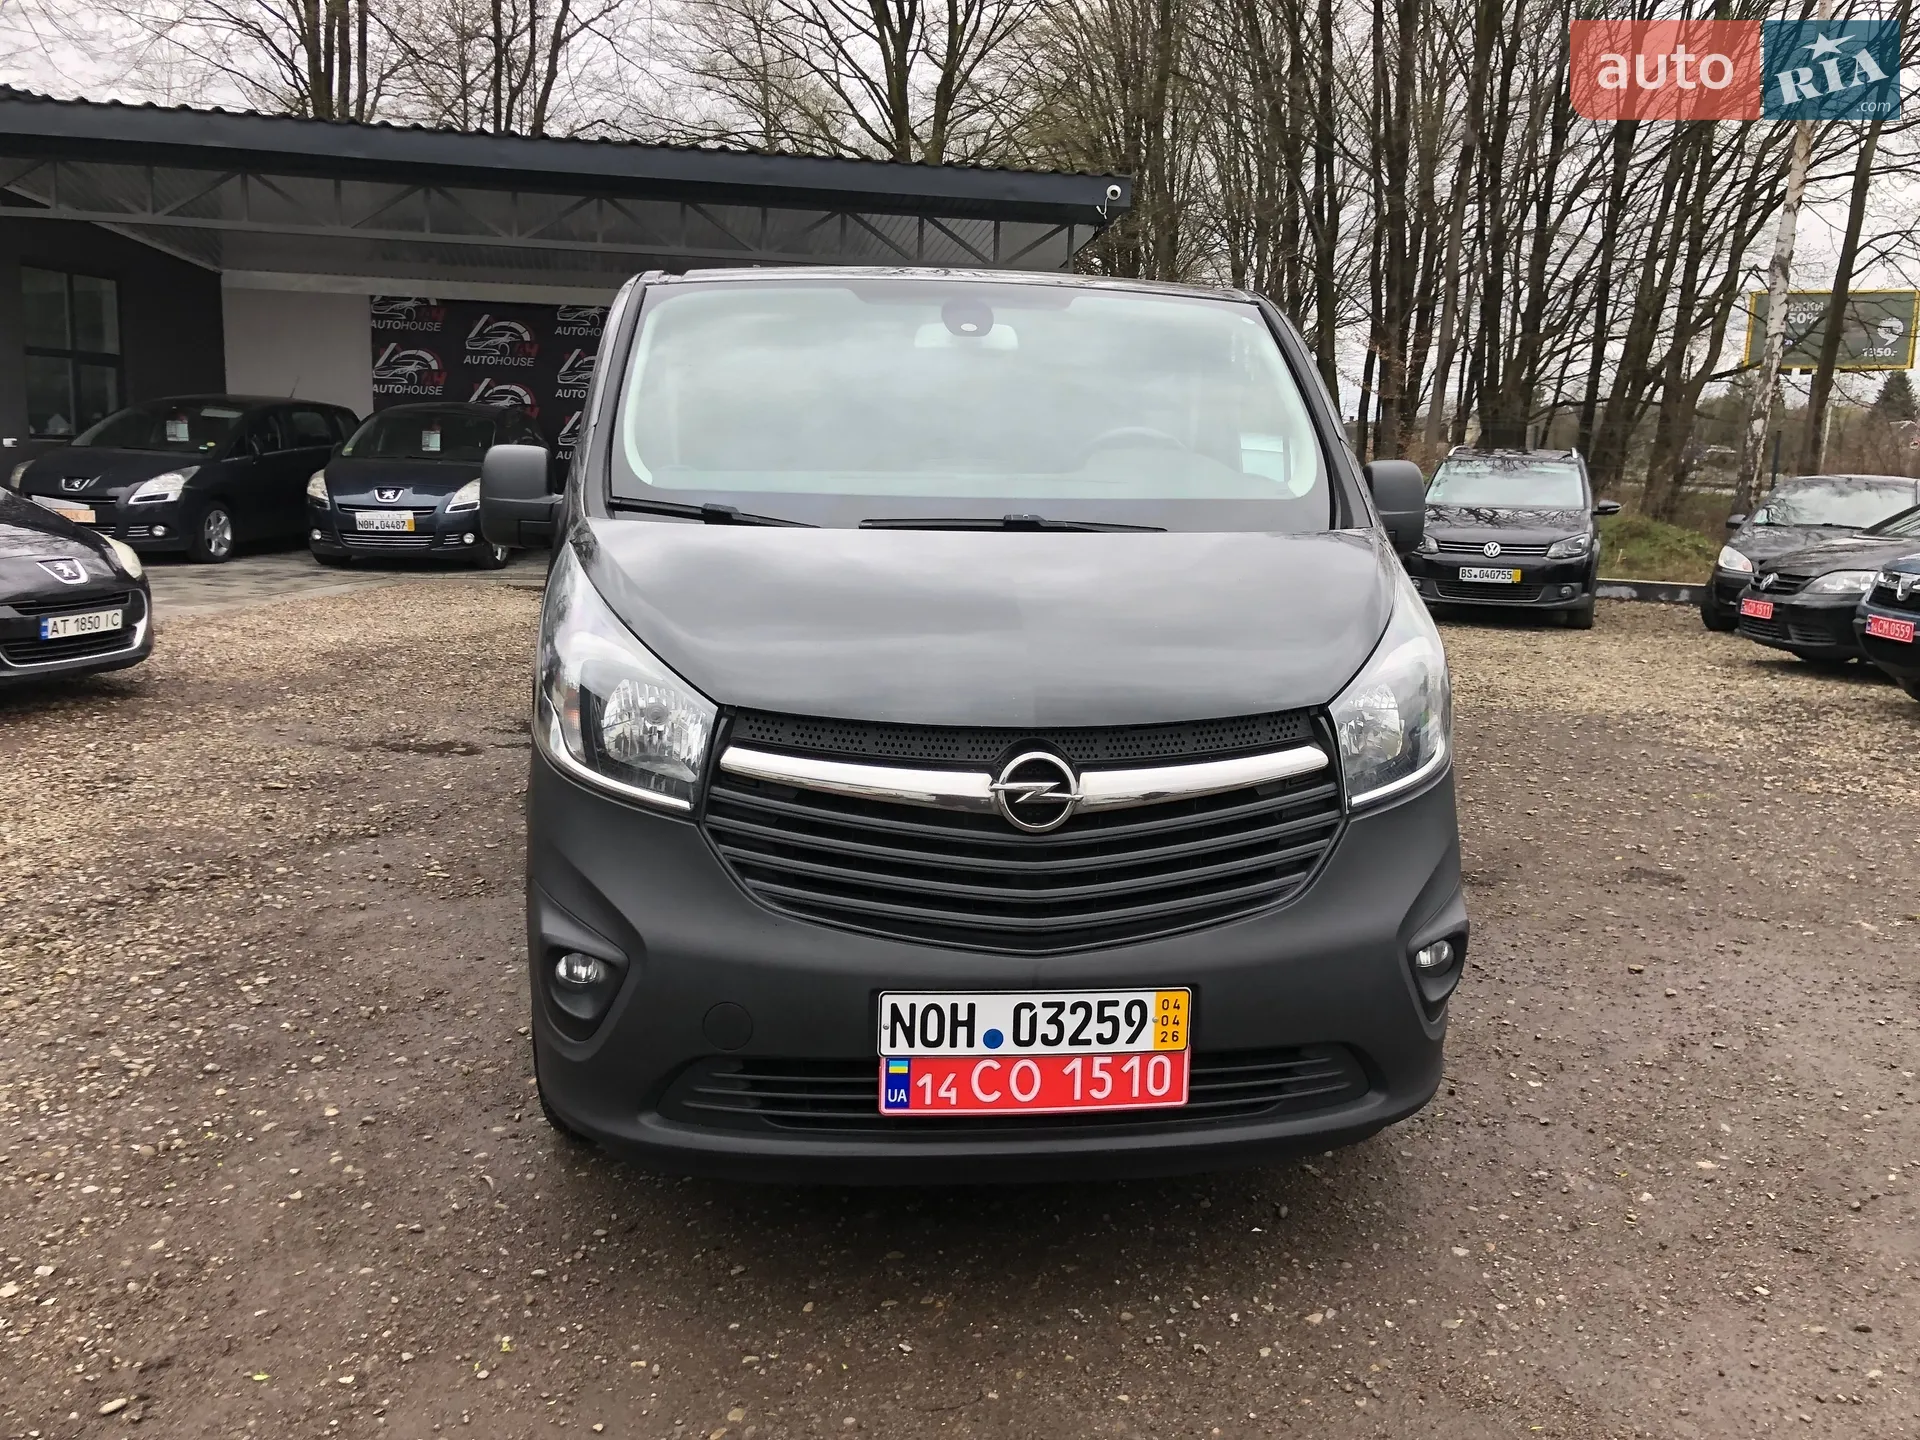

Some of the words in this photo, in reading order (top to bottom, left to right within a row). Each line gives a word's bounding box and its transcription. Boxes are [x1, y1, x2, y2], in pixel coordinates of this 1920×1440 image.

[371, 319, 442, 332] AUTOHOUSE
[555, 326, 602, 337] AUTOHO
[463, 355, 535, 367] AUTOHOUSE
[372, 384, 444, 395] AUTOHOUSE
[1461, 568, 1473, 579] BS
[50, 618, 70, 636] AT
[74, 615, 100, 632] 1850
[1890, 622, 1911, 639] 0559
[1161, 998, 1181, 1011] 04
[889, 1001, 976, 1049] NOH
[1012, 998, 1148, 1048] 03259
[1160, 1014, 1180, 1027] 04
[1160, 1030, 1180, 1043] 26
[916, 1072, 957, 1106] 14
[970, 1059, 1042, 1104] CO
[1061, 1054, 1172, 1101] 1510
[887, 1088, 907, 1103] UA
